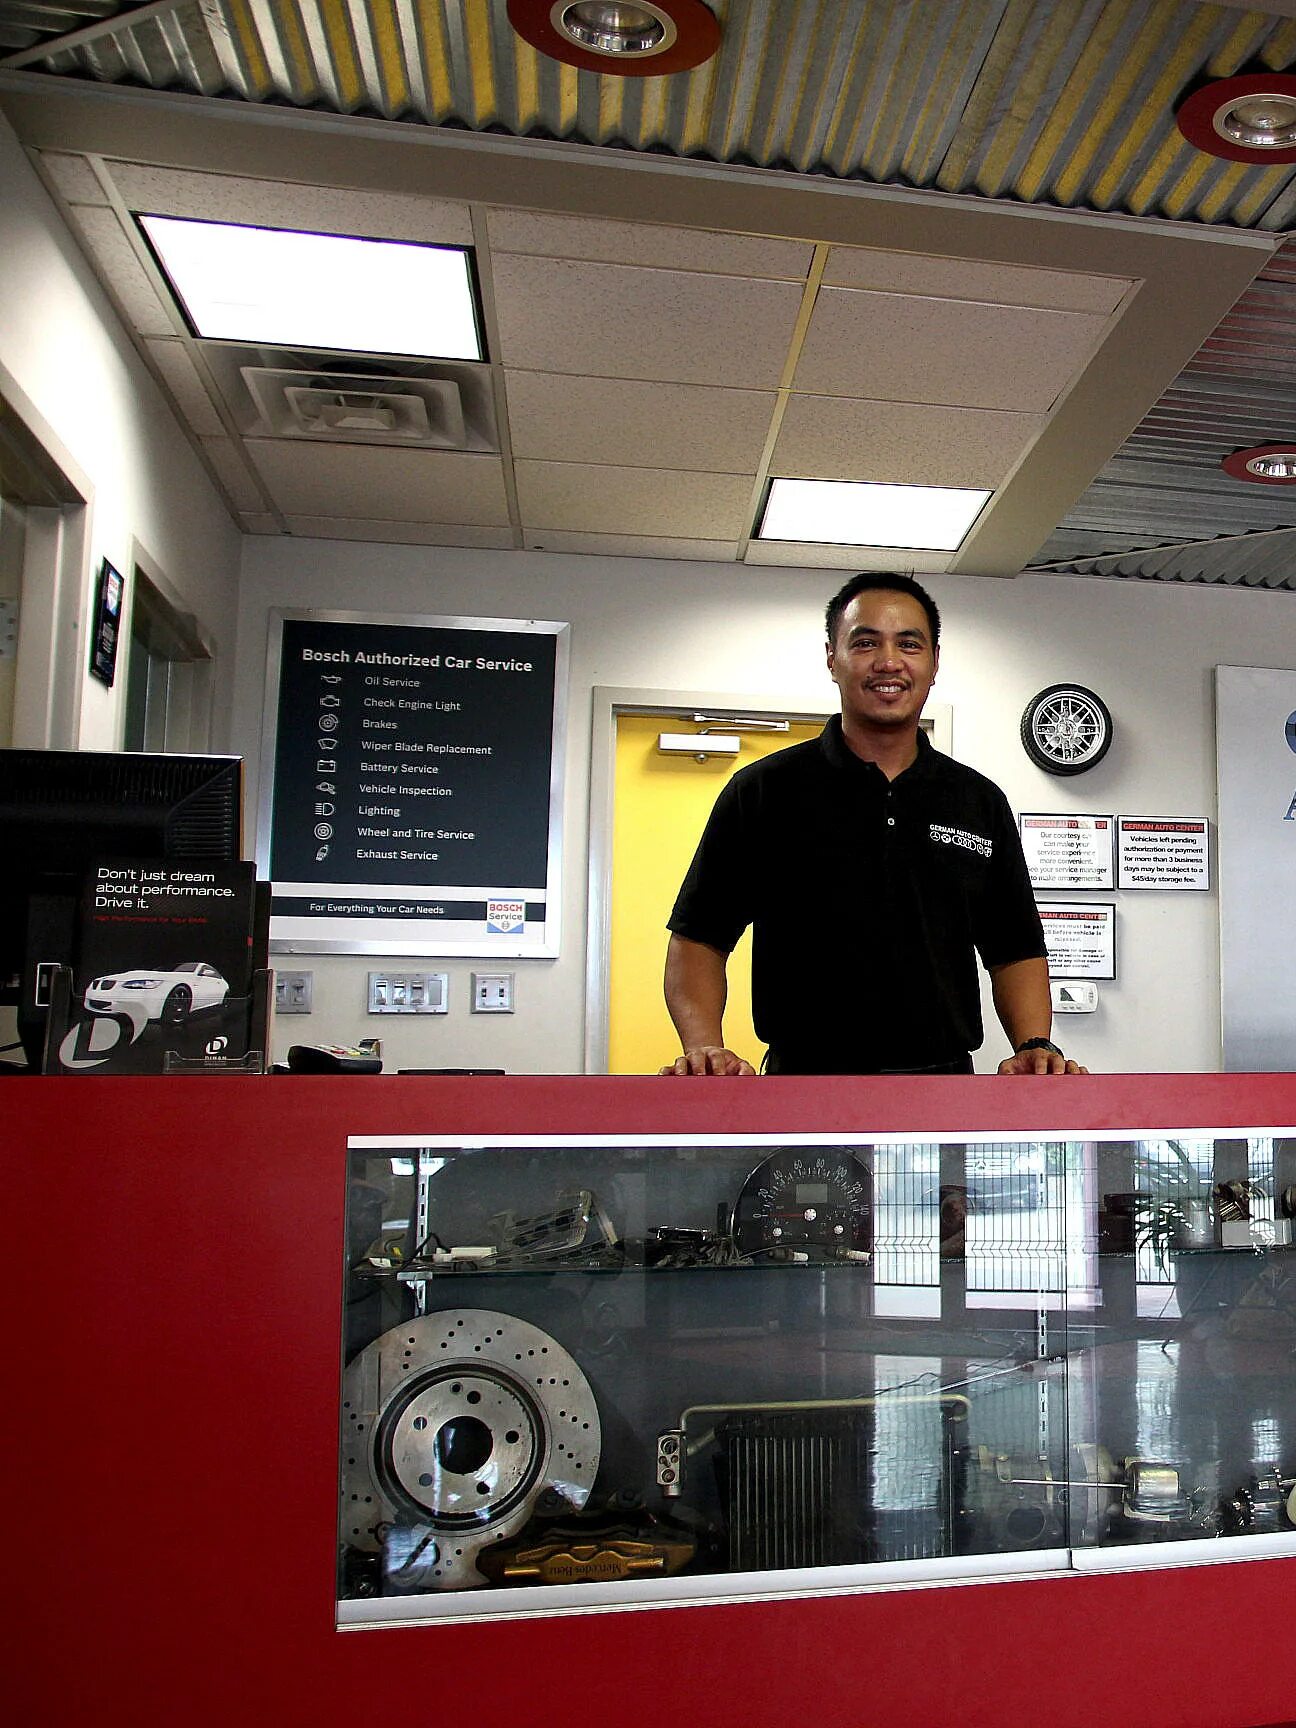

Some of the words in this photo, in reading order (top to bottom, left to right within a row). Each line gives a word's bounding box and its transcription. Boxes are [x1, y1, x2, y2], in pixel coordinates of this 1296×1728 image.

[302, 649, 350, 663] Bosch
[355, 651, 440, 667] Authorized
[444, 656, 471, 669] Car
[475, 657, 533, 672] Service
[364, 676, 379, 686] Oil
[382, 677, 420, 688] Service
[363, 698, 395, 707] Check
[398, 699, 433, 711] Engine
[435, 701, 461, 712] Light
[362, 719, 398, 729] Brakes
[361, 741, 392, 751] Wiper
[395, 742, 424, 752] Blade
[426, 743, 492, 755] Replacement
[360, 762, 398, 774] Battery
[400, 763, 439, 774] Service
[359, 784, 396, 794] Vehicle
[399, 785, 452, 797] Inspection
[358, 805, 400, 817] Lighting
[357, 827, 389, 837] Wheel
[392, 829, 411, 838] and
[414, 829, 434, 838] Tire
[436, 829, 475, 840] Service
[929, 824, 956, 834] GERMAN
[1054, 832, 1080, 840] courtesy
[356, 849, 397, 859] Exhaust
[400, 850, 438, 860] Service
[1123, 865, 1140, 873] days
[97, 868, 137, 880] Don't
[139, 869, 167, 881] just
[170, 871, 215, 882] dream
[95, 883, 139, 894] about
[141, 885, 235, 897] performance.
[95, 896, 133, 908] Drive
[137, 897, 149, 909] it.
[489, 903, 523, 912] BOSCH
[310, 903, 324, 911] For
[327, 904, 374, 914] Everything
[376, 904, 396, 913] Your
[398, 905, 415, 913] Car
[416, 905, 444, 914] Needs
[488, 912, 523, 921] Service
[793, 1159, 803, 1170] 60
[816, 1158, 825, 1169] 80
[773, 1169, 783, 1180] 40
[757, 1188, 769, 1199] 20
